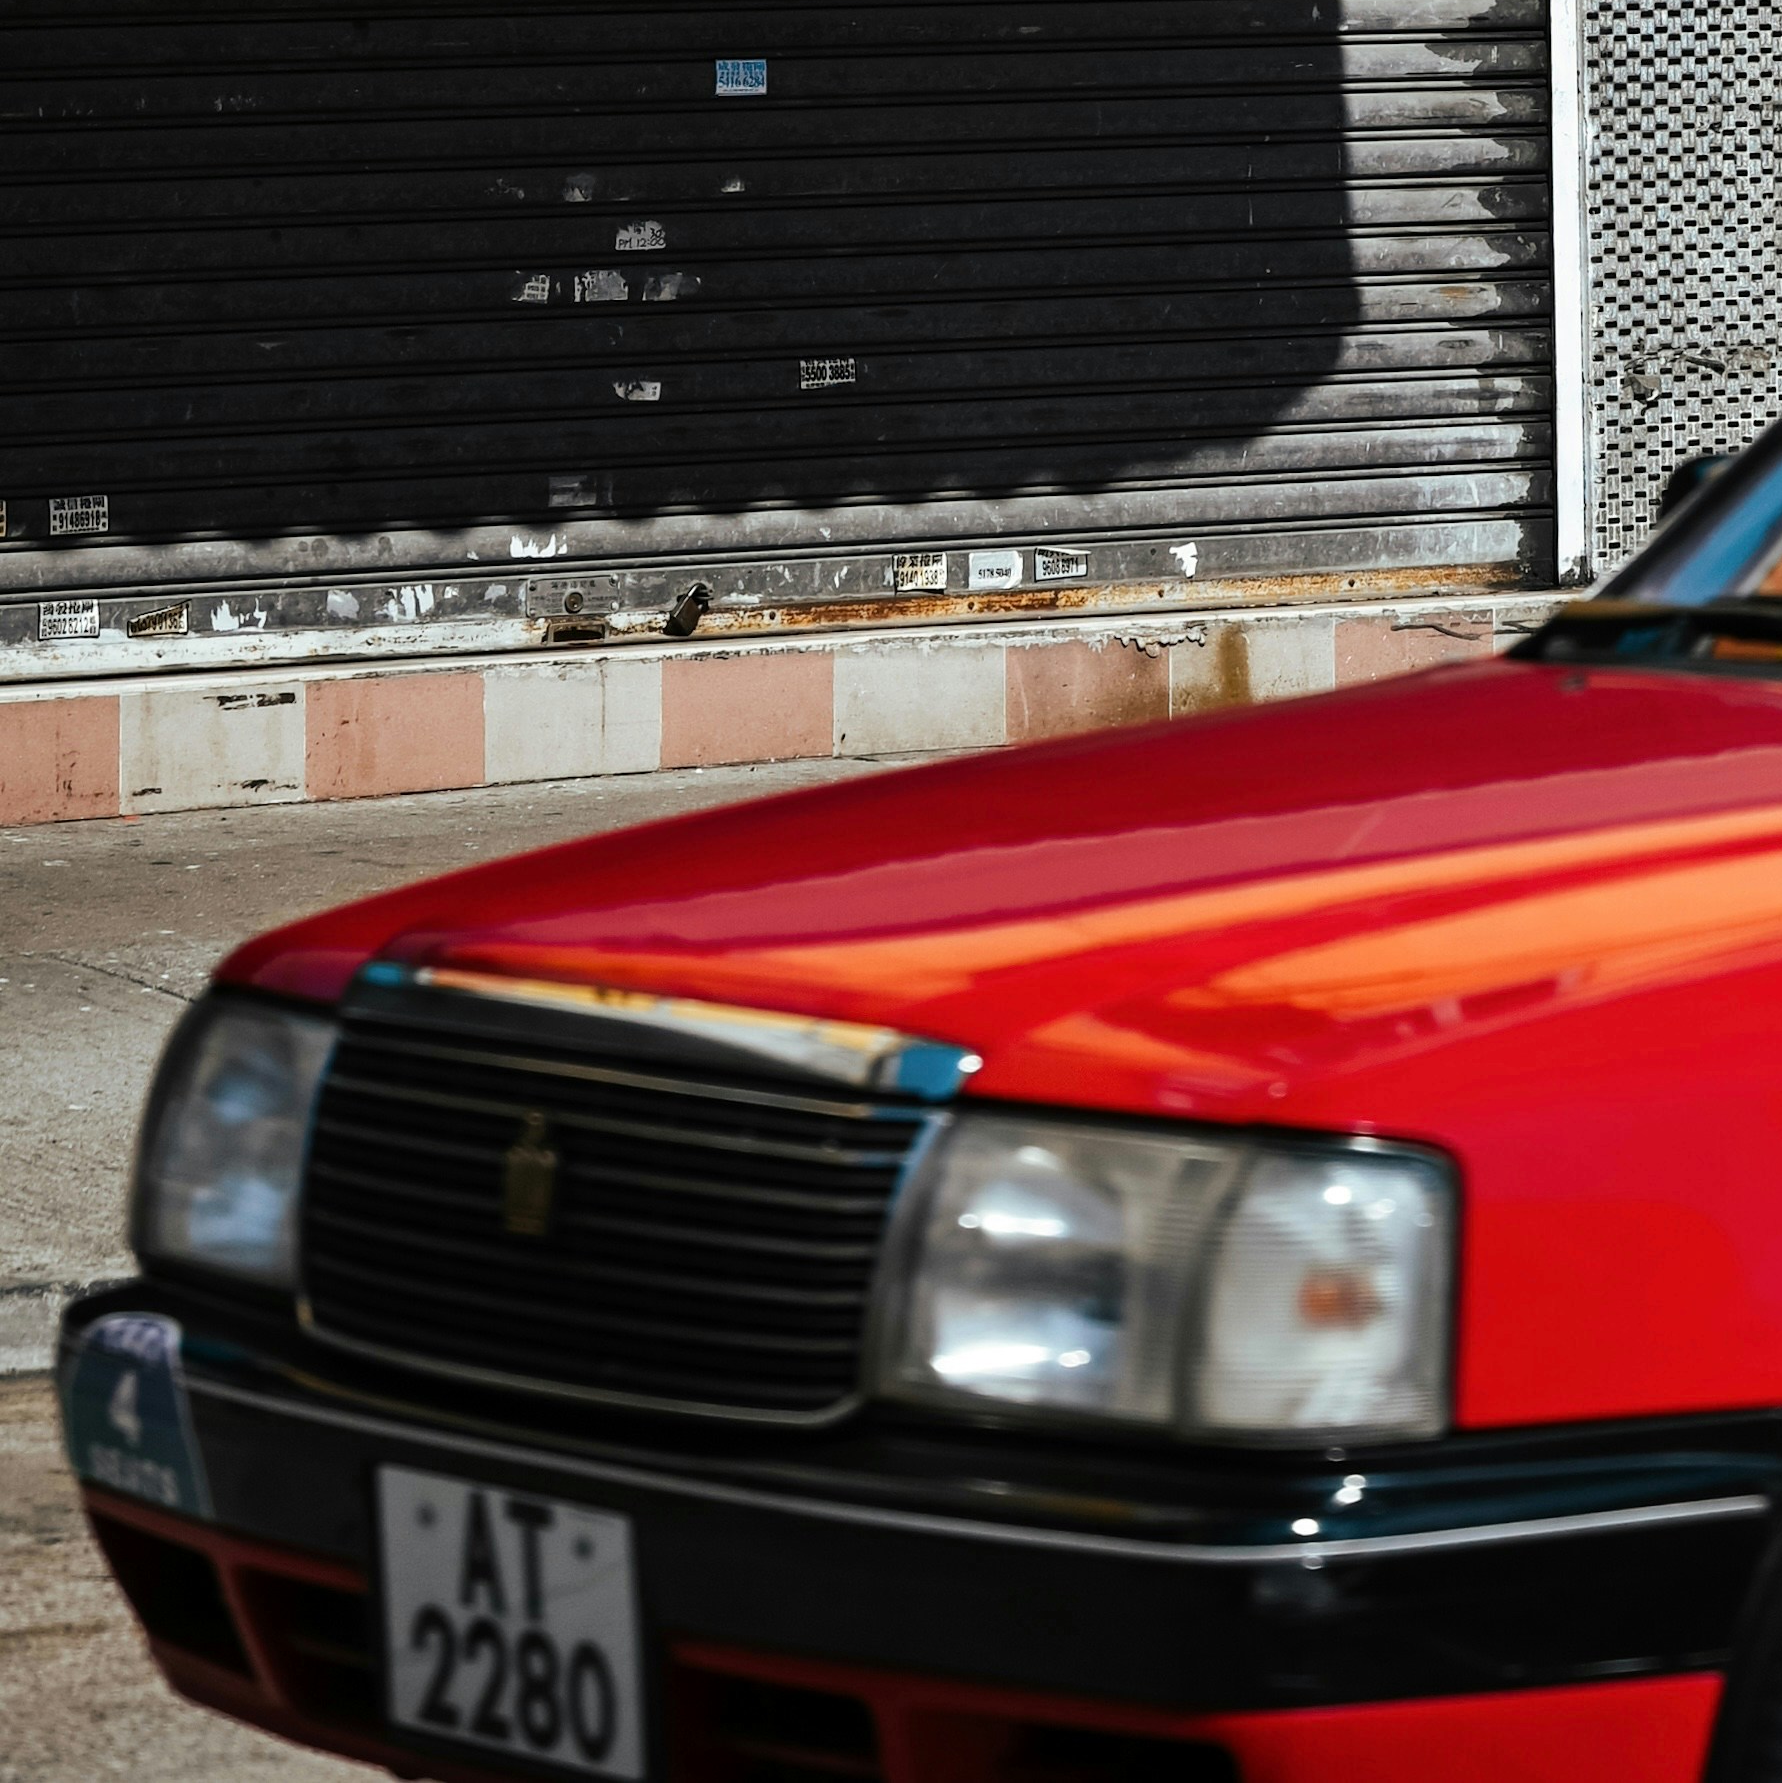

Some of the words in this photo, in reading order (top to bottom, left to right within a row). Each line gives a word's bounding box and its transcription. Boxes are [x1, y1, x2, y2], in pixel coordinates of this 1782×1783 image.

[618, 237, 632, 249] PM
[108, 1370, 143, 1448] 4
[458, 1490, 554, 1621] AT
[408, 1603, 617, 1763] 2280
